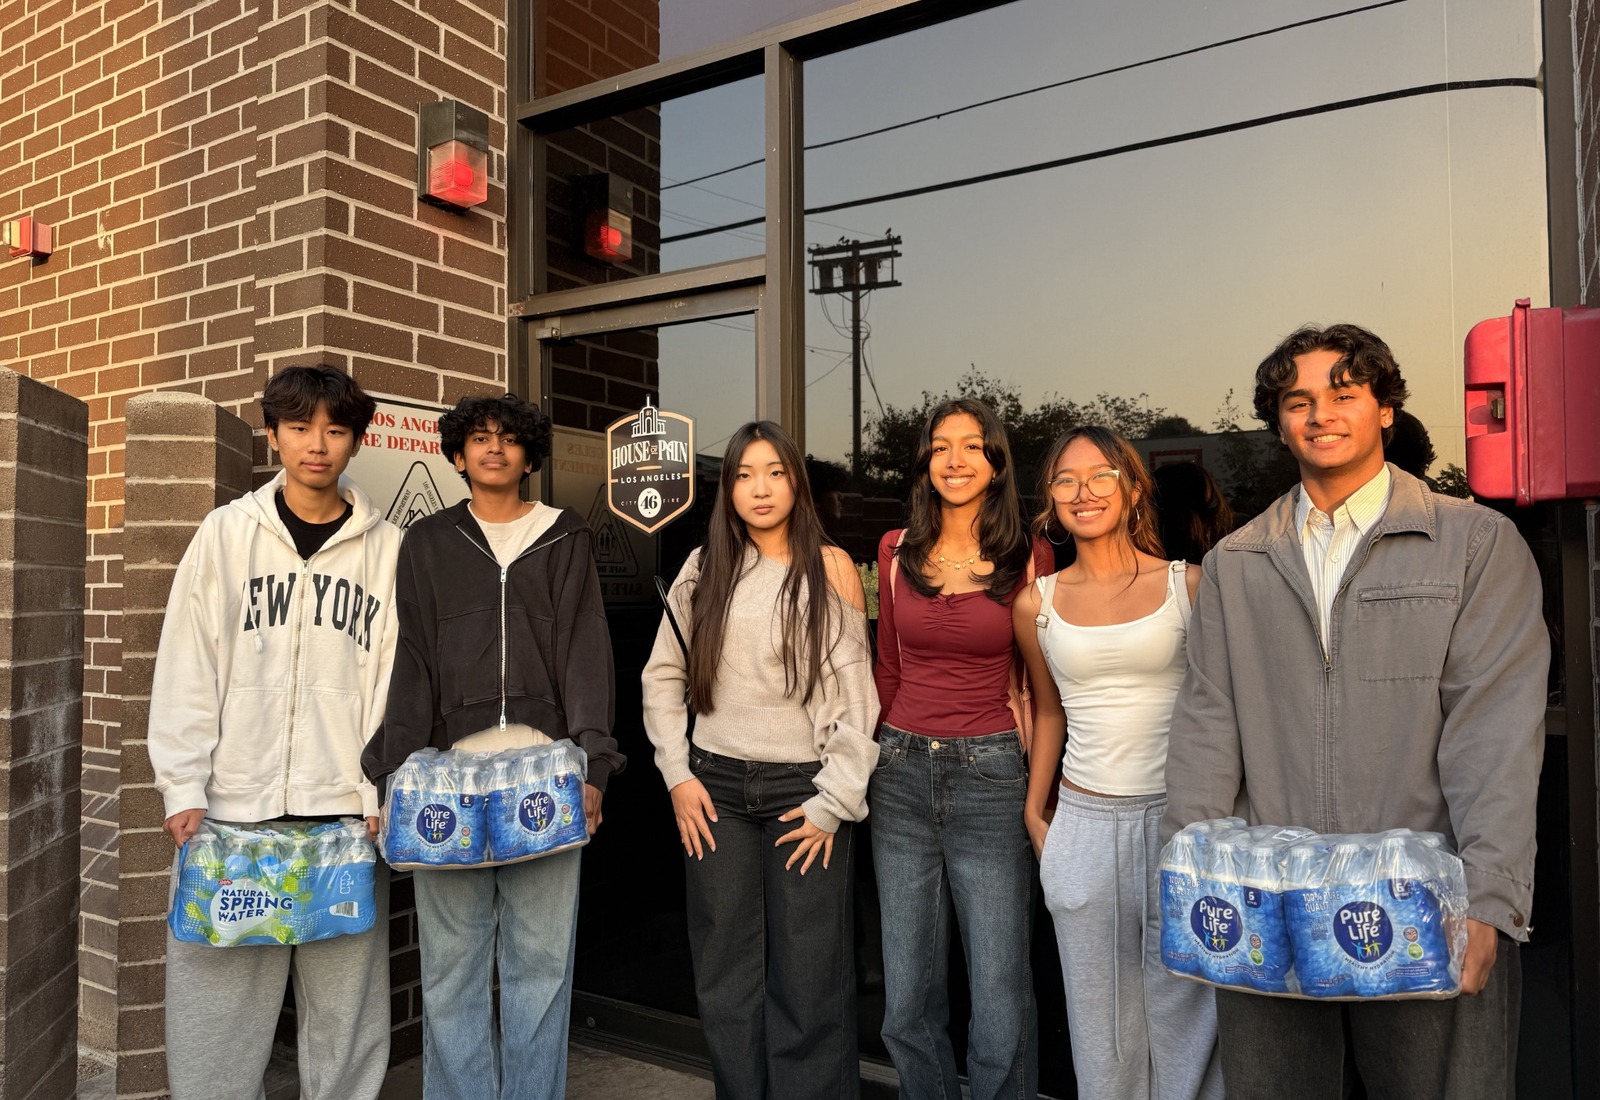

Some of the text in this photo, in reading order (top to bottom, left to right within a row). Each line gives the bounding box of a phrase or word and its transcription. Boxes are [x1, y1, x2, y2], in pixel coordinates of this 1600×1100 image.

[370, 412, 396, 428] OS
[612, 440, 651, 470] HOUSE
[658, 439, 688, 464] PAIN
[620, 472, 681, 484] LOS ANGELES
[640, 495, 658, 510] 46
[242, 572, 381, 653] EW YORK
[463, 796, 470, 804] 6
[523, 796, 549, 809] Pure
[423, 807, 450, 819] Pure
[527, 806, 547, 819] Life
[425, 818, 446, 832] Life
[221, 888, 271, 897] NATURAL
[1248, 891, 1255, 901] 6
[219, 896, 293, 911] SPRING
[1199, 900, 1233, 920] Pure
[1340, 908, 1381, 925] Pure
[1202, 915, 1229, 935] Life
[1348, 922, 1380, 943] Life
[1344, 956, 1369, 971] HEALTHY
[1369, 950, 1396, 971] HYDRATION
